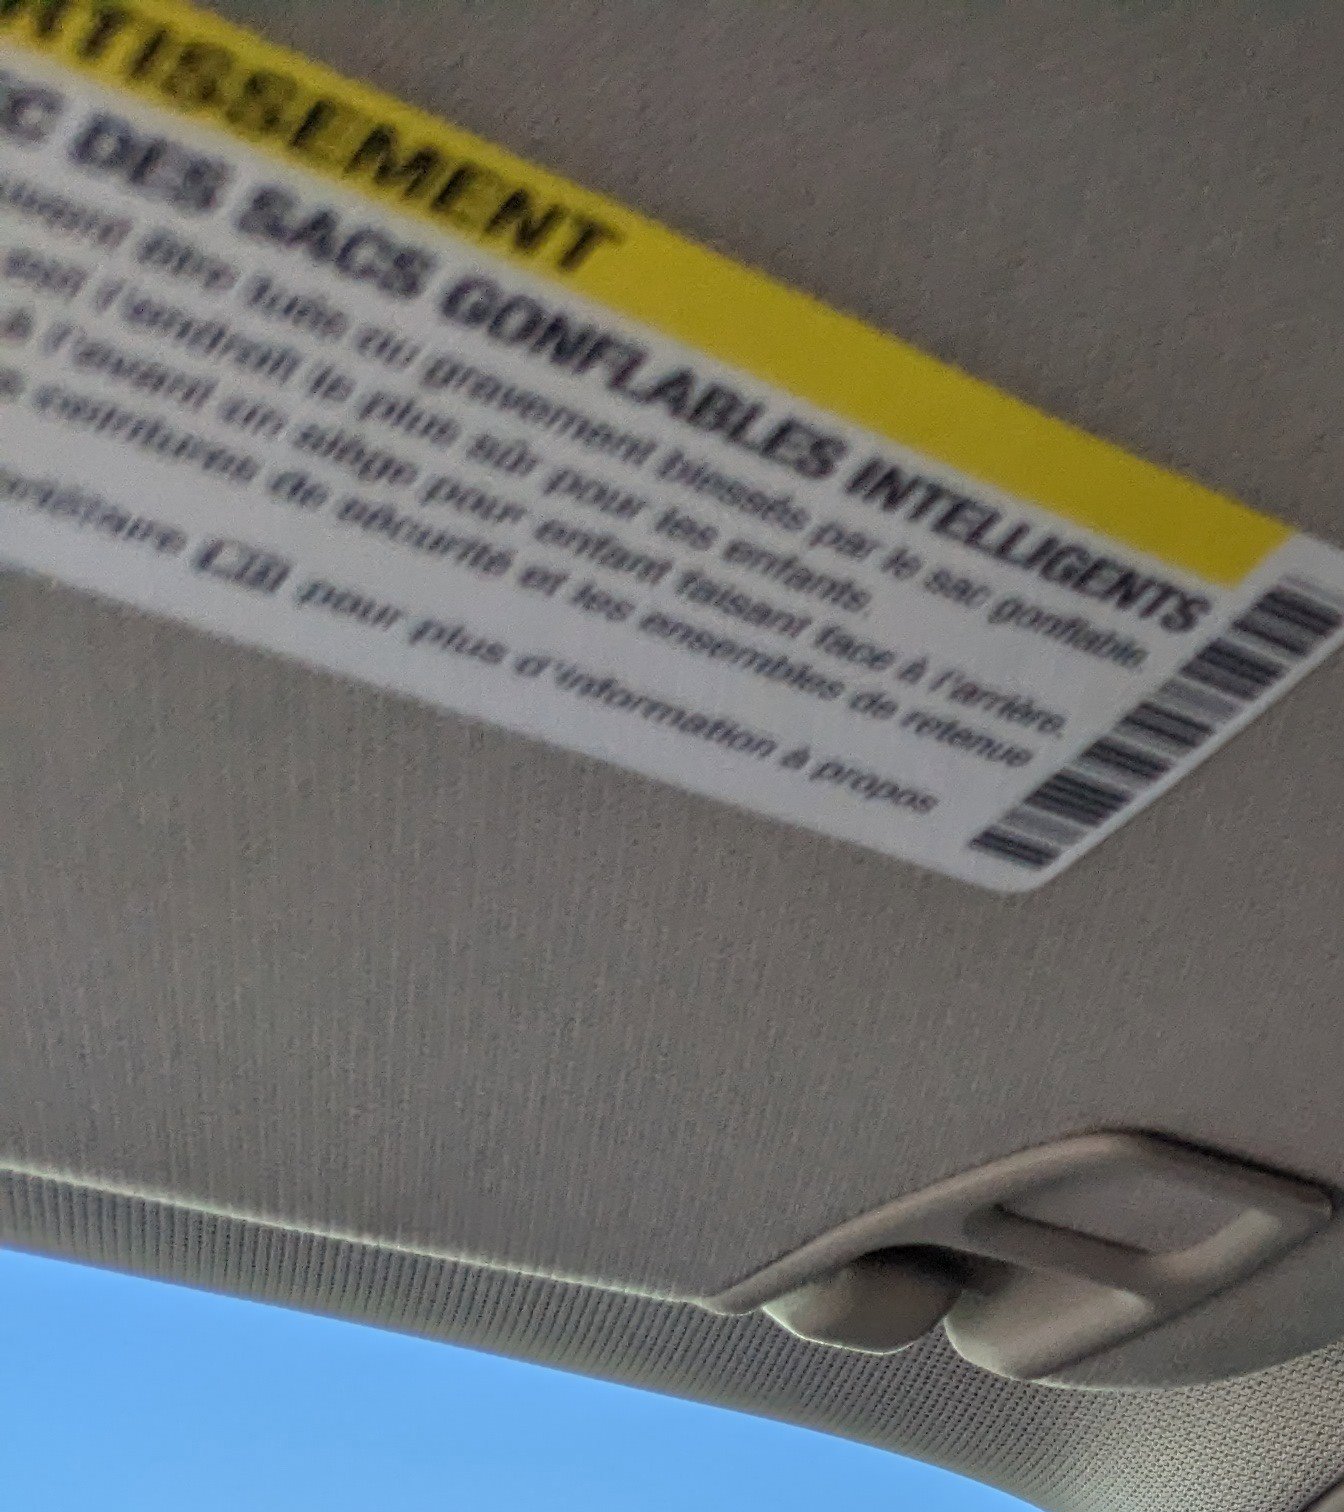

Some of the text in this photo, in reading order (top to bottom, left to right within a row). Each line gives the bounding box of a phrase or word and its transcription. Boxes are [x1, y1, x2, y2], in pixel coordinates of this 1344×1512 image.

[66, 113, 229, 212] DES
[234, 184, 436, 300] SACS
[437, 274, 848, 480] GONFLABLES
[843, 456, 1212, 633] INTELLIGENTS
